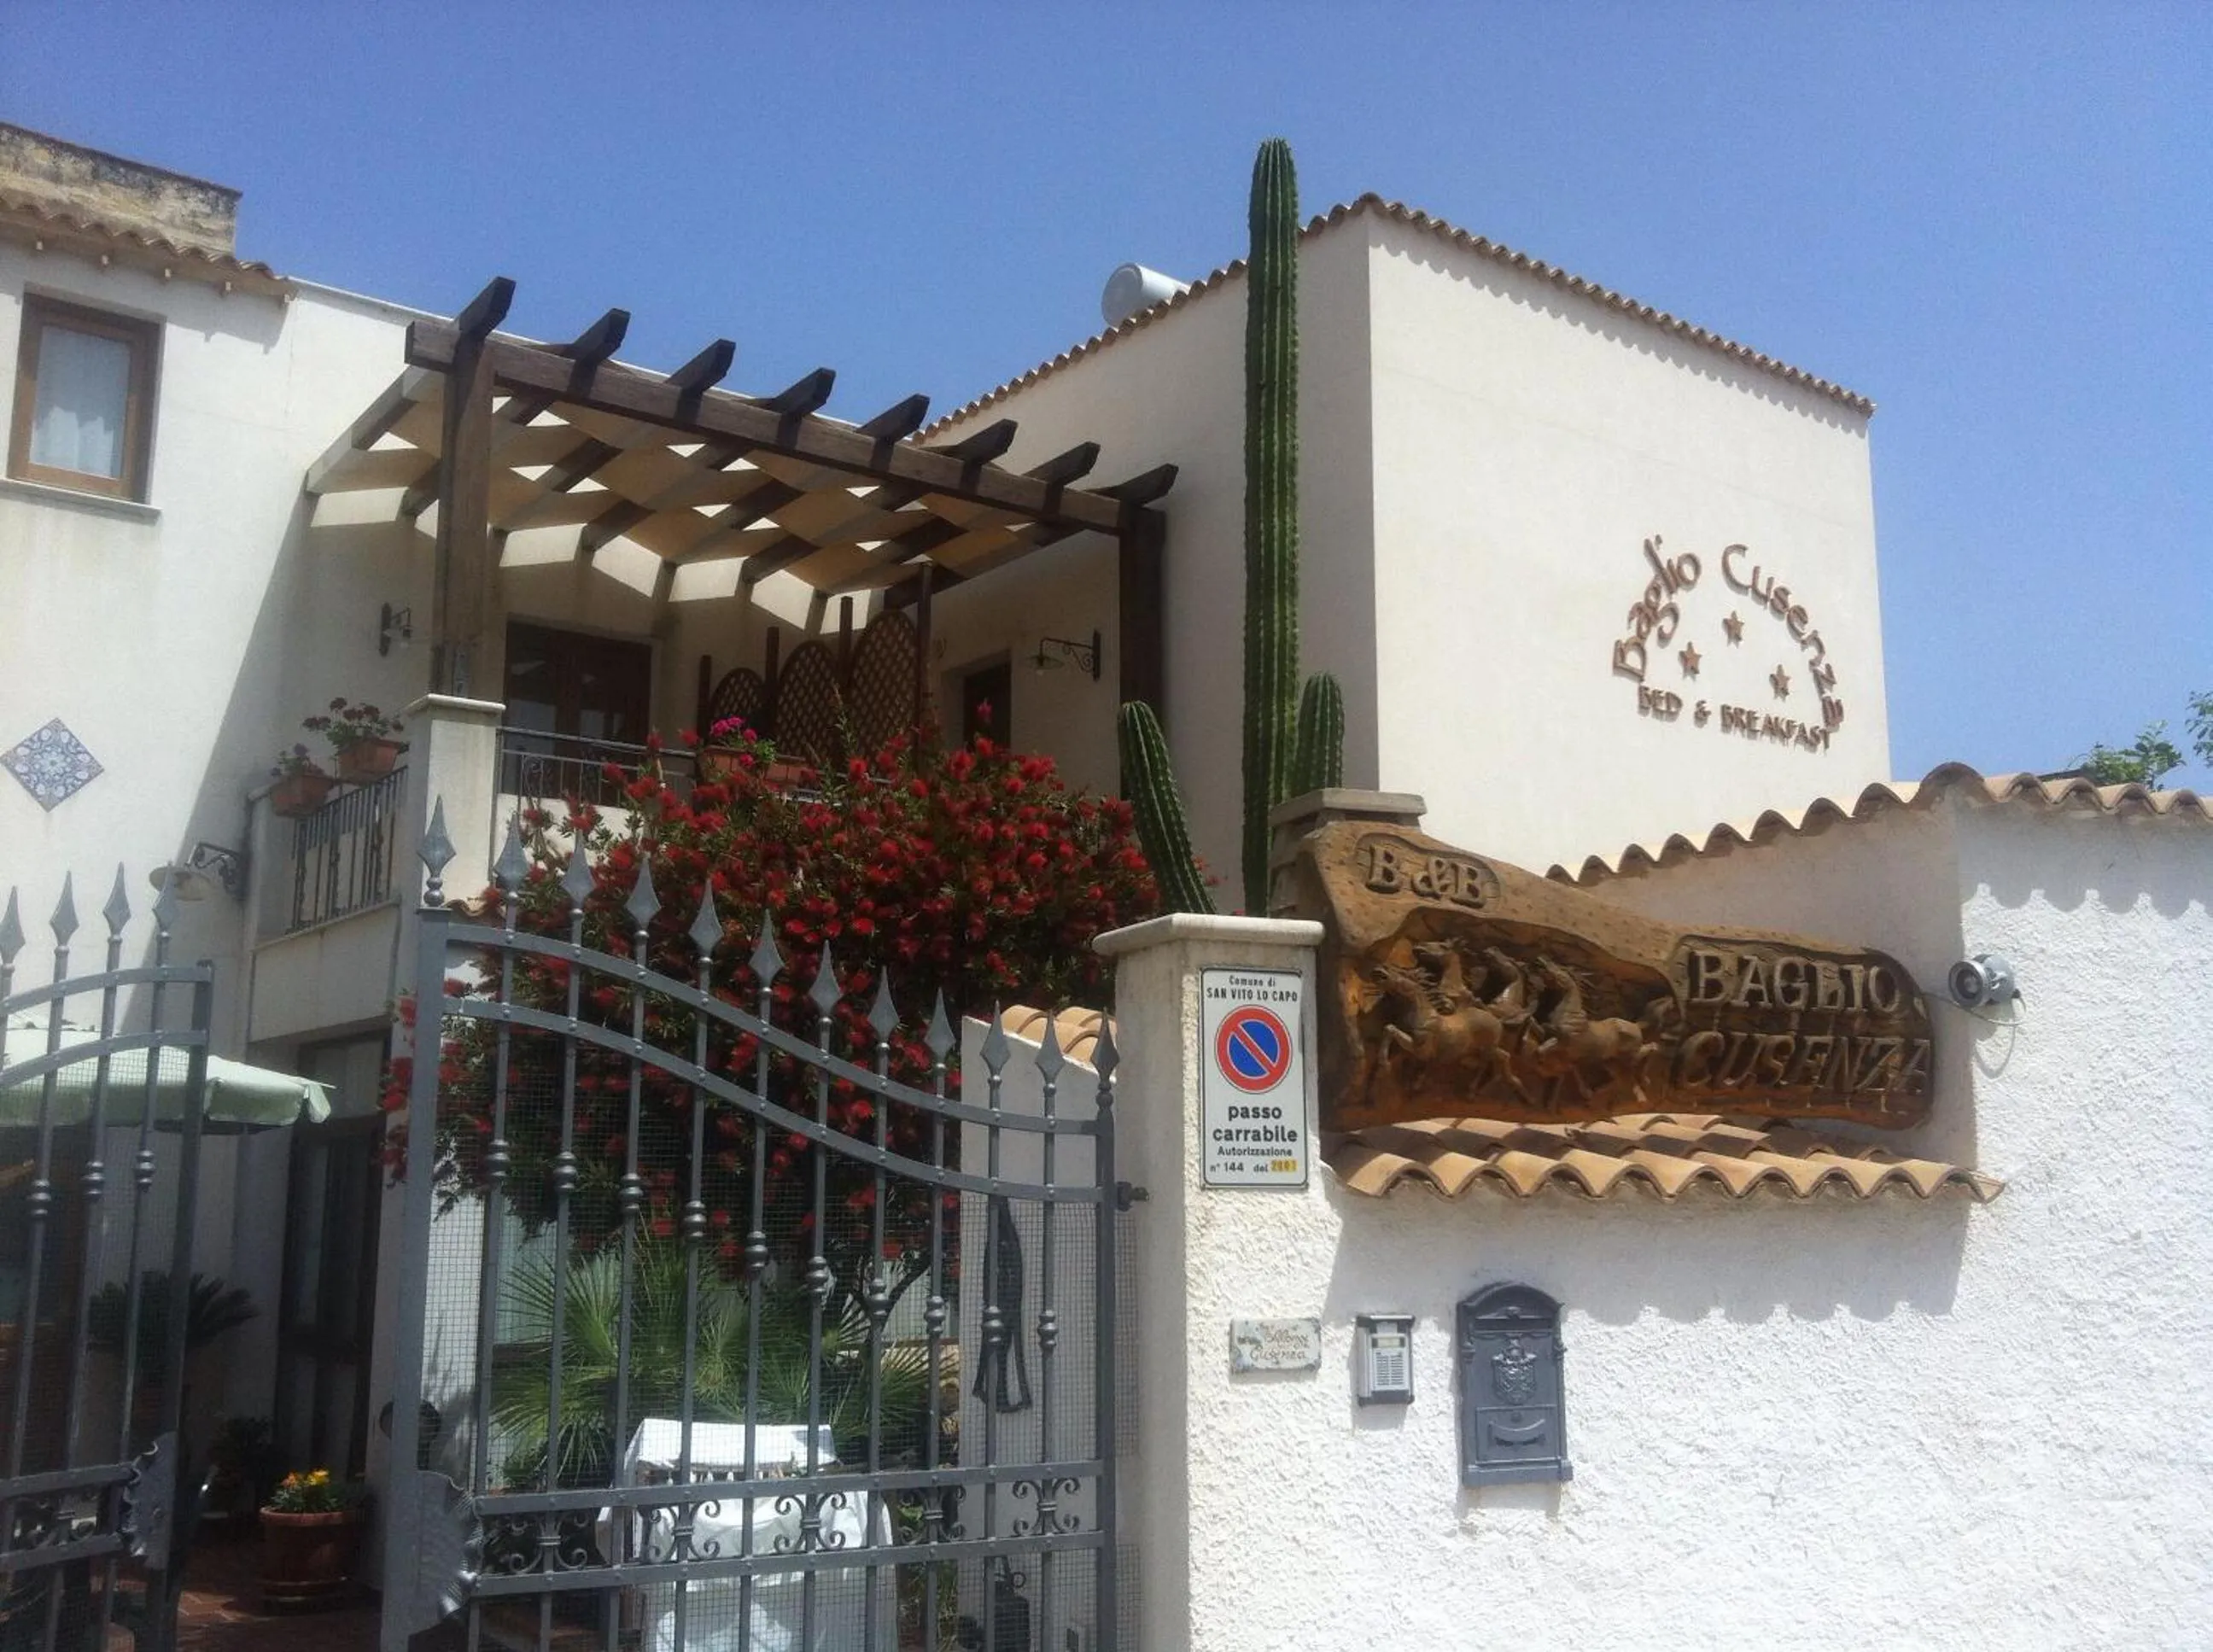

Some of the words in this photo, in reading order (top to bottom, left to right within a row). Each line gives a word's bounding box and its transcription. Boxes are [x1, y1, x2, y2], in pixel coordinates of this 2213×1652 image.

[1638, 686, 1683, 721] BED
[1720, 704, 1831, 753] BREAKFAST
[1229, 975, 1264, 986] Comune
[1268, 977, 1276, 987] di
[1689, 949, 1901, 1013] BAGLIO
[1206, 988, 1227, 999] SAN
[1230, 989, 1253, 1000] VITO
[1271, 991, 1298, 1001] CAPO
[1228, 1105, 1282, 1122] passo
[1212, 1125, 1298, 1142] carrabile
[1217, 1146, 1293, 1157] Autorizzazione
[1224, 1162, 1244, 1172] 144
[1253, 1164, 1269, 1173] del
